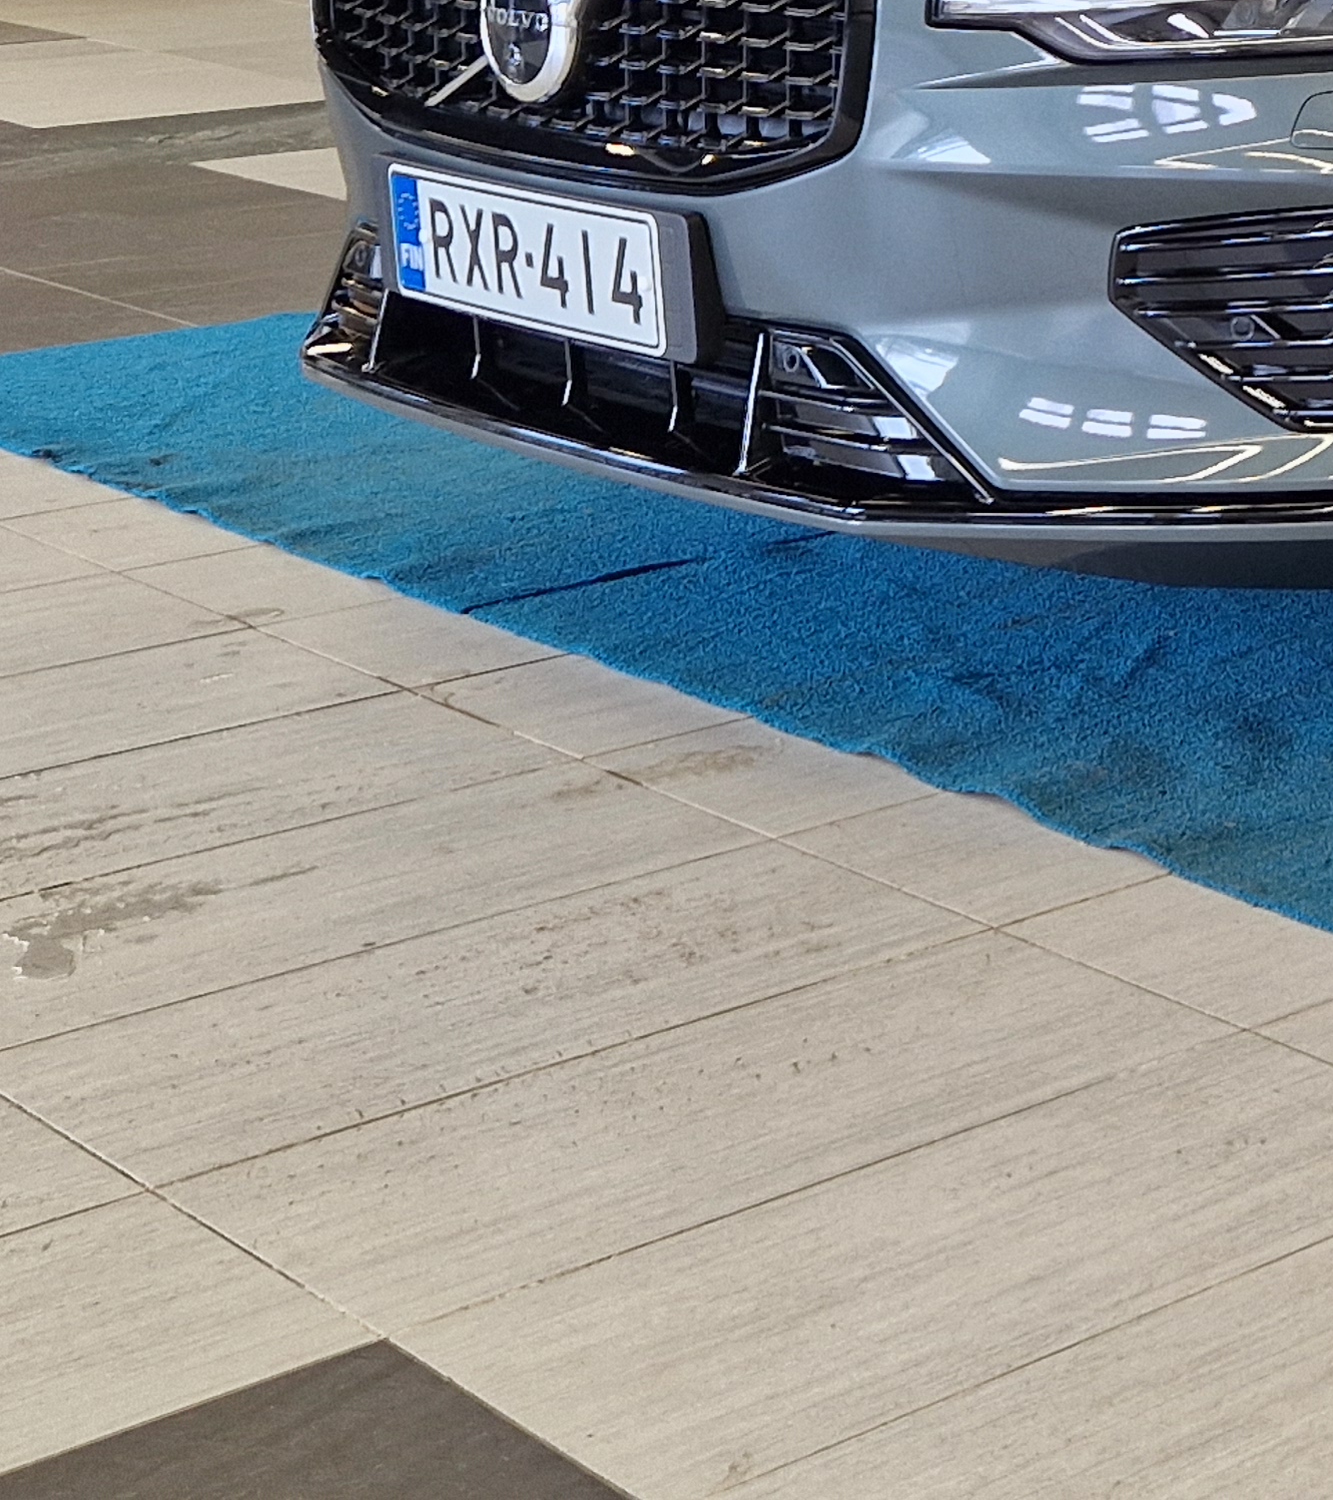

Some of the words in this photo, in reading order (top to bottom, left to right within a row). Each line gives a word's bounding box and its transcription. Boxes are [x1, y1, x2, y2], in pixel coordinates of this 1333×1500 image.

[487, 6, 549, 33] VOLVO
[400, 242, 424, 271] FIN
[428, 197, 643, 325] RXR-414
